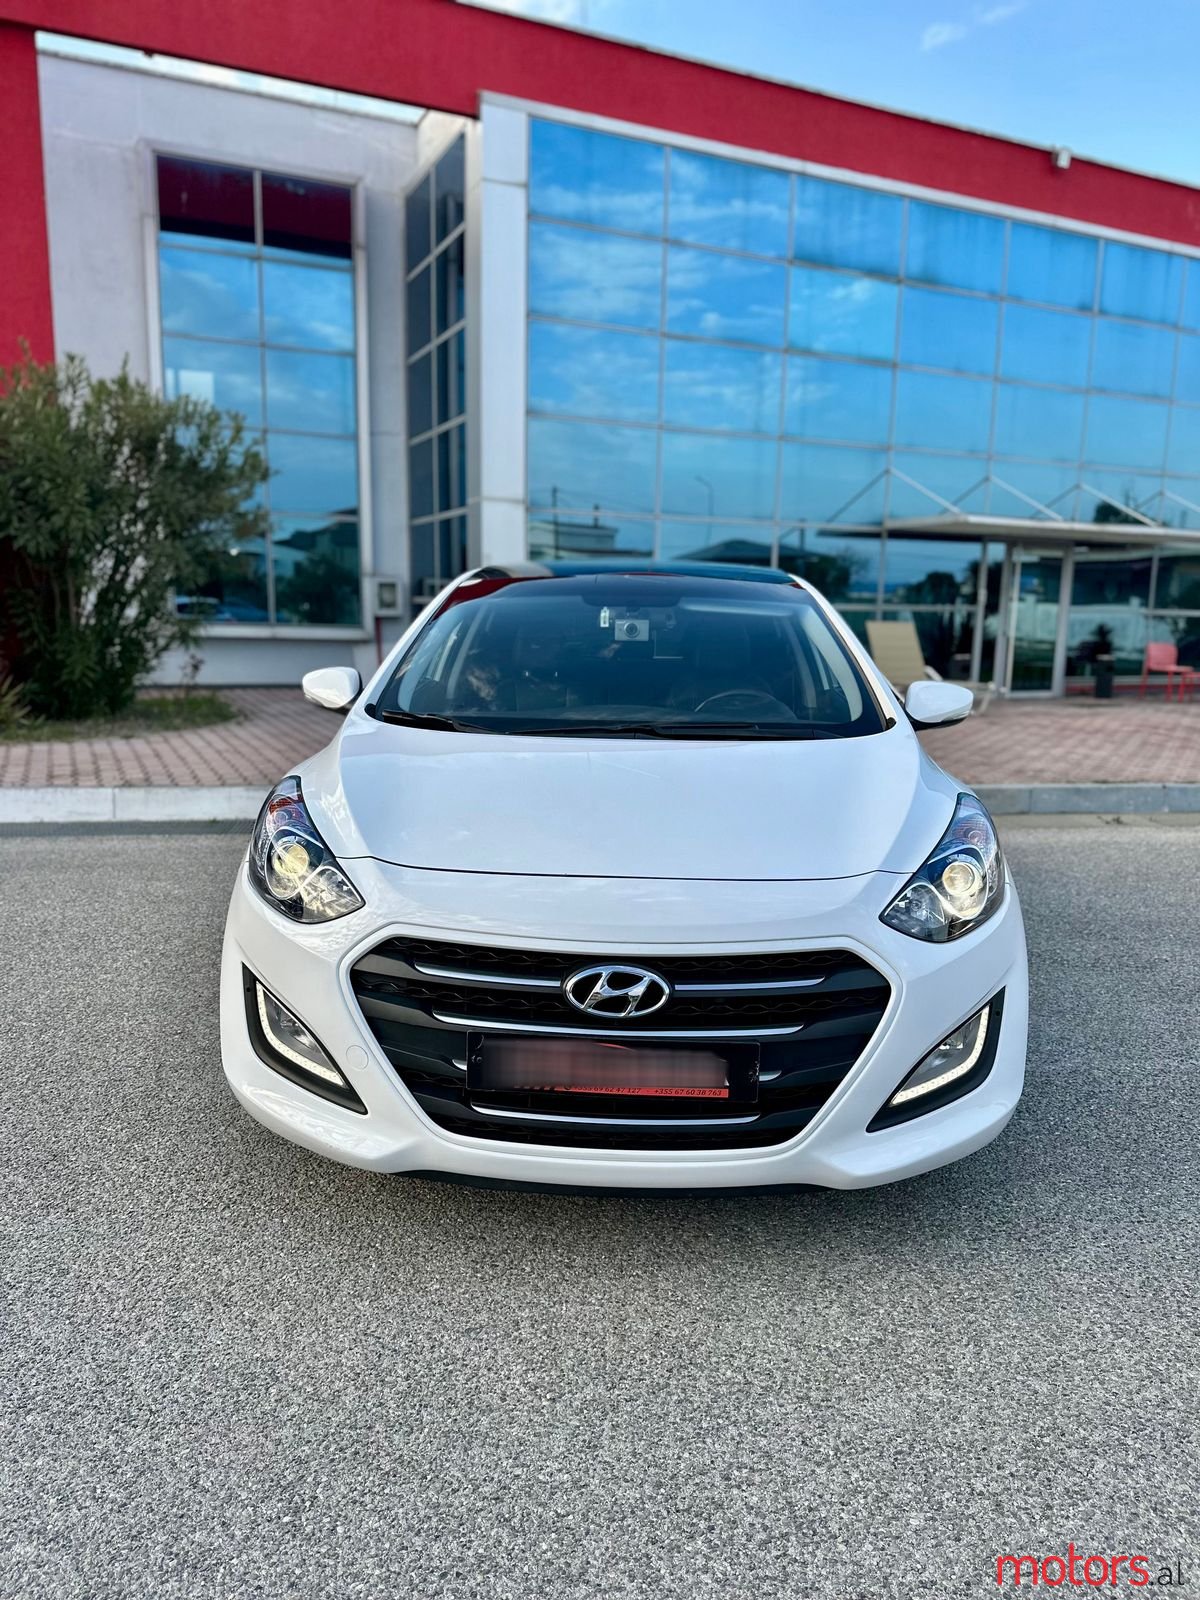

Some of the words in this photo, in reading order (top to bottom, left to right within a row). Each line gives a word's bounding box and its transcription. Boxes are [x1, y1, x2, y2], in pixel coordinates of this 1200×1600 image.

[628, 1086, 642, 1095] 127
[674, 1088, 684, 1096] 67
[708, 1089, 722, 1097] 763
